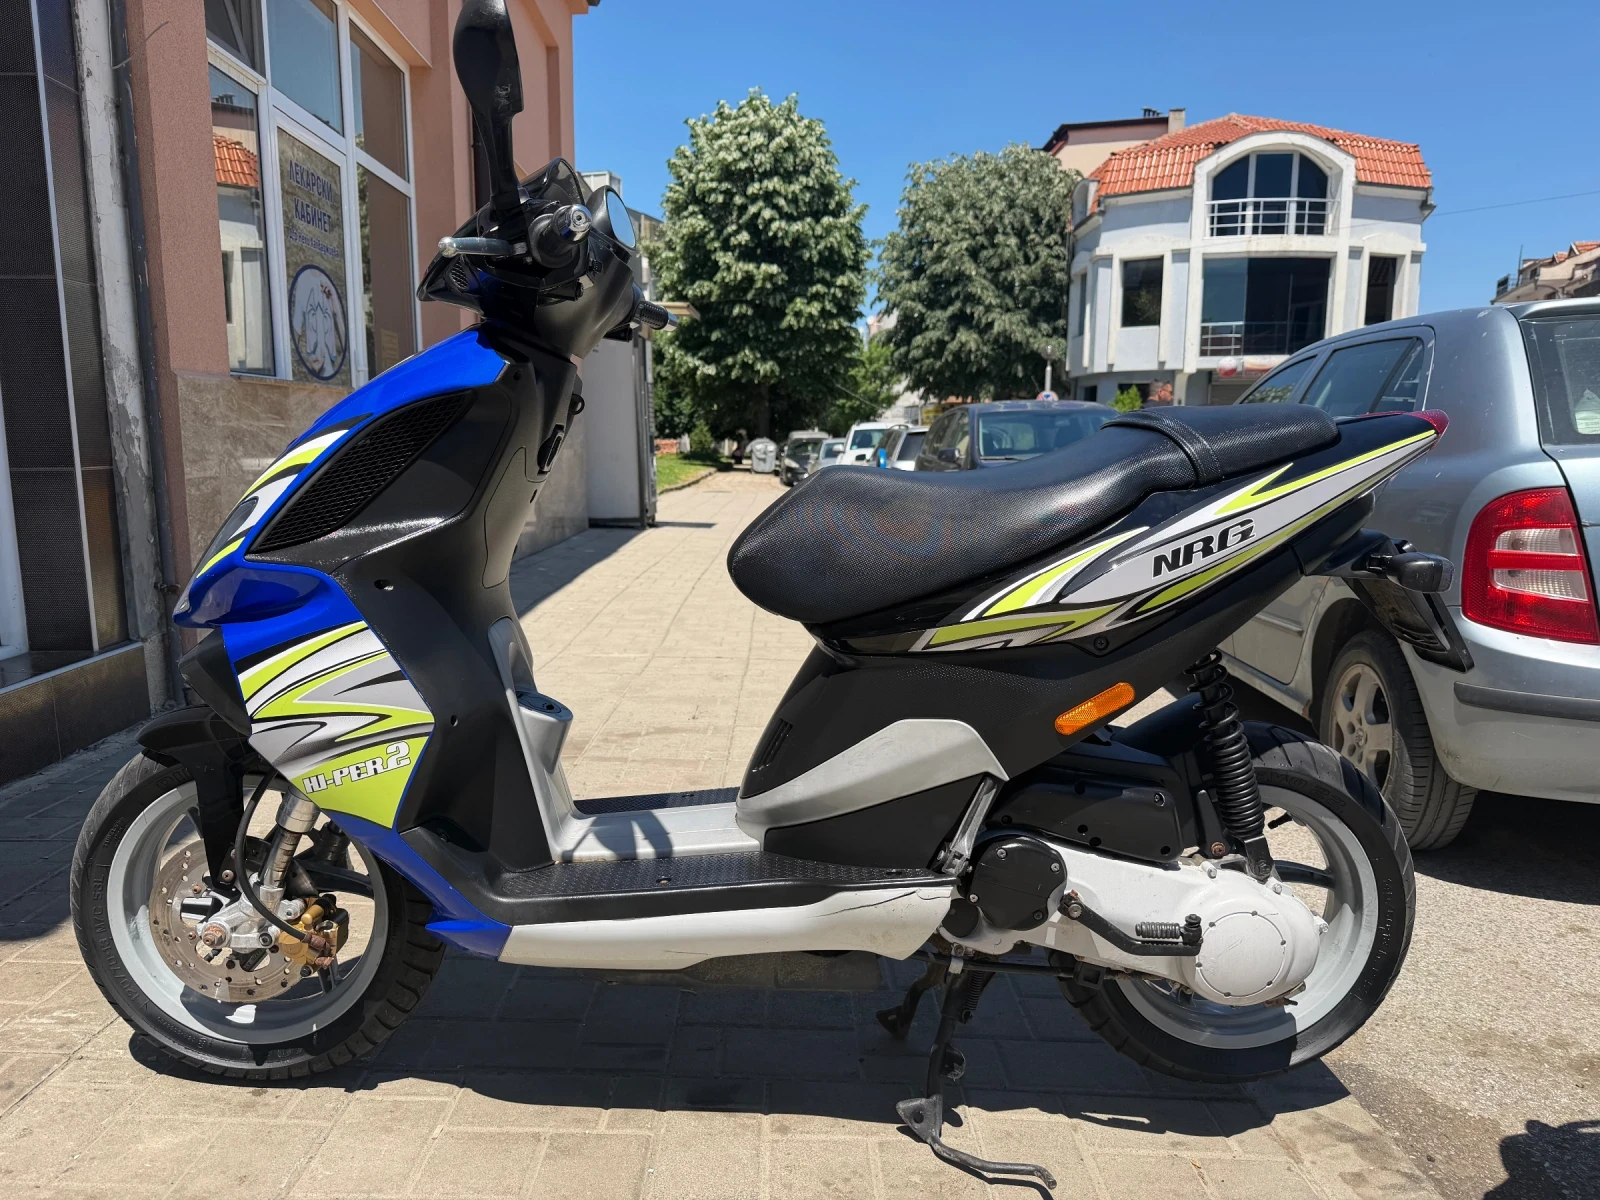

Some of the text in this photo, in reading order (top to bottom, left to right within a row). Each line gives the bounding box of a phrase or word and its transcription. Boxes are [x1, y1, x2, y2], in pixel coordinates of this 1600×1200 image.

[289, 159, 333, 203] ЛЕКАРСКИ
[294, 197, 332, 234] КАБИНЕТ
[1152, 519, 1256, 579] NRG
